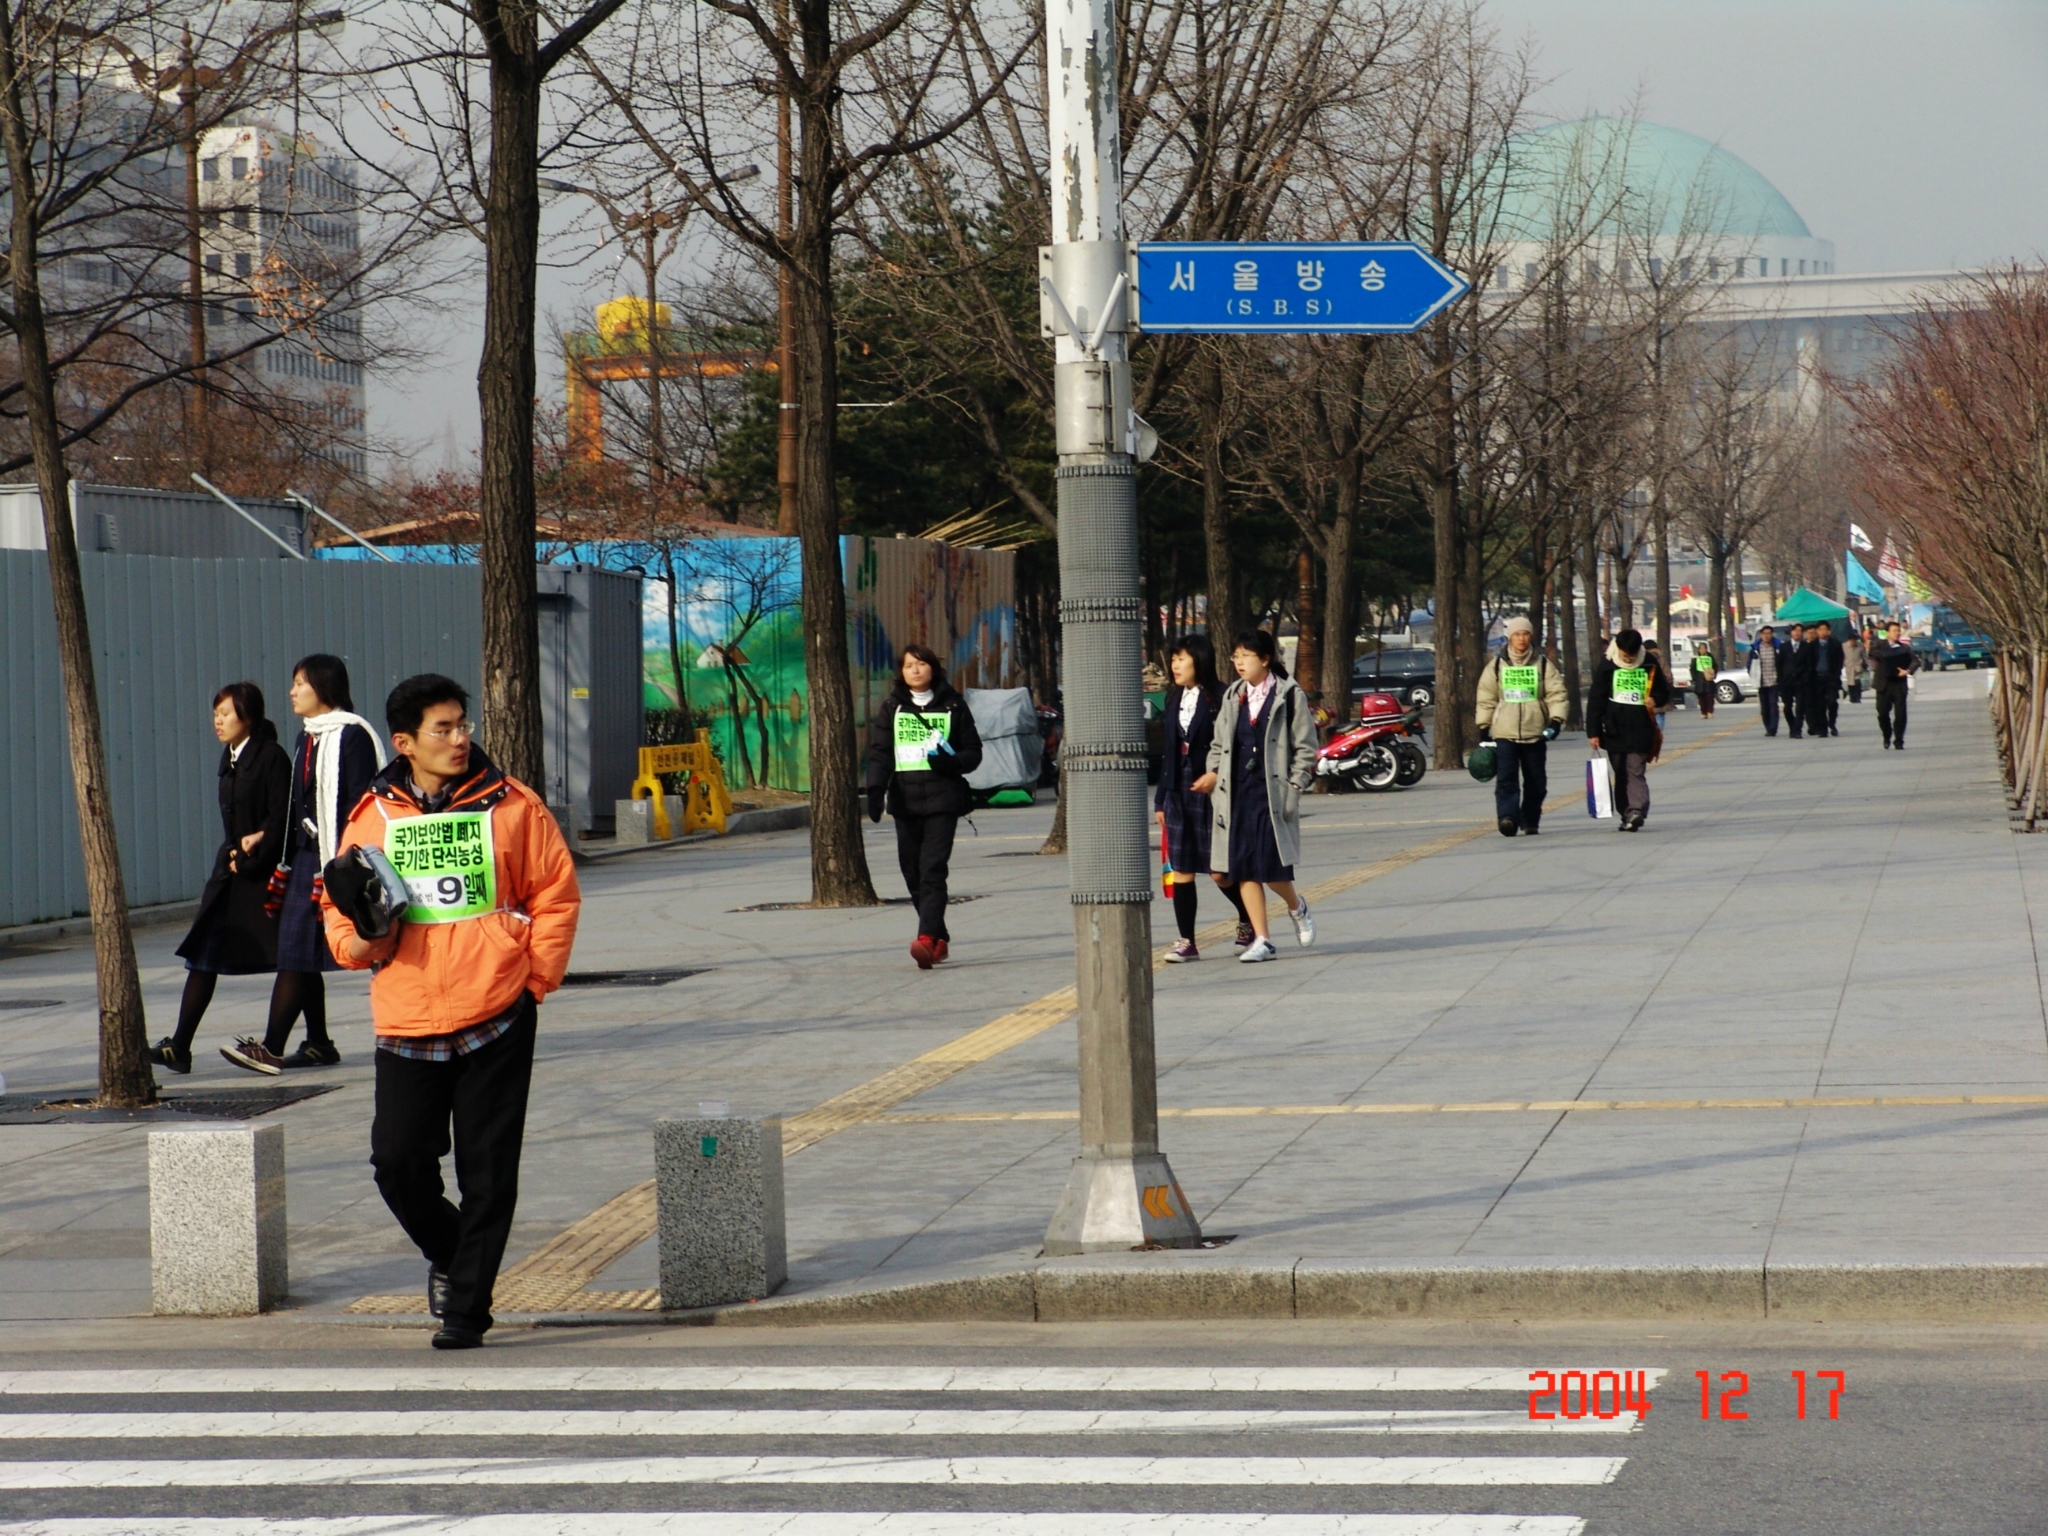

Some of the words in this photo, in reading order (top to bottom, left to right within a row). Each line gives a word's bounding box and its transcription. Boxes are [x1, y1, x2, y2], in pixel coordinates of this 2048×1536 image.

[1631, 692, 1640, 702] 8
[395, 821, 453, 847] 국가보안법
[456, 820, 481, 843] 폐지
[394, 848, 430, 872] 무기한
[432, 843, 484, 869] 단식농성
